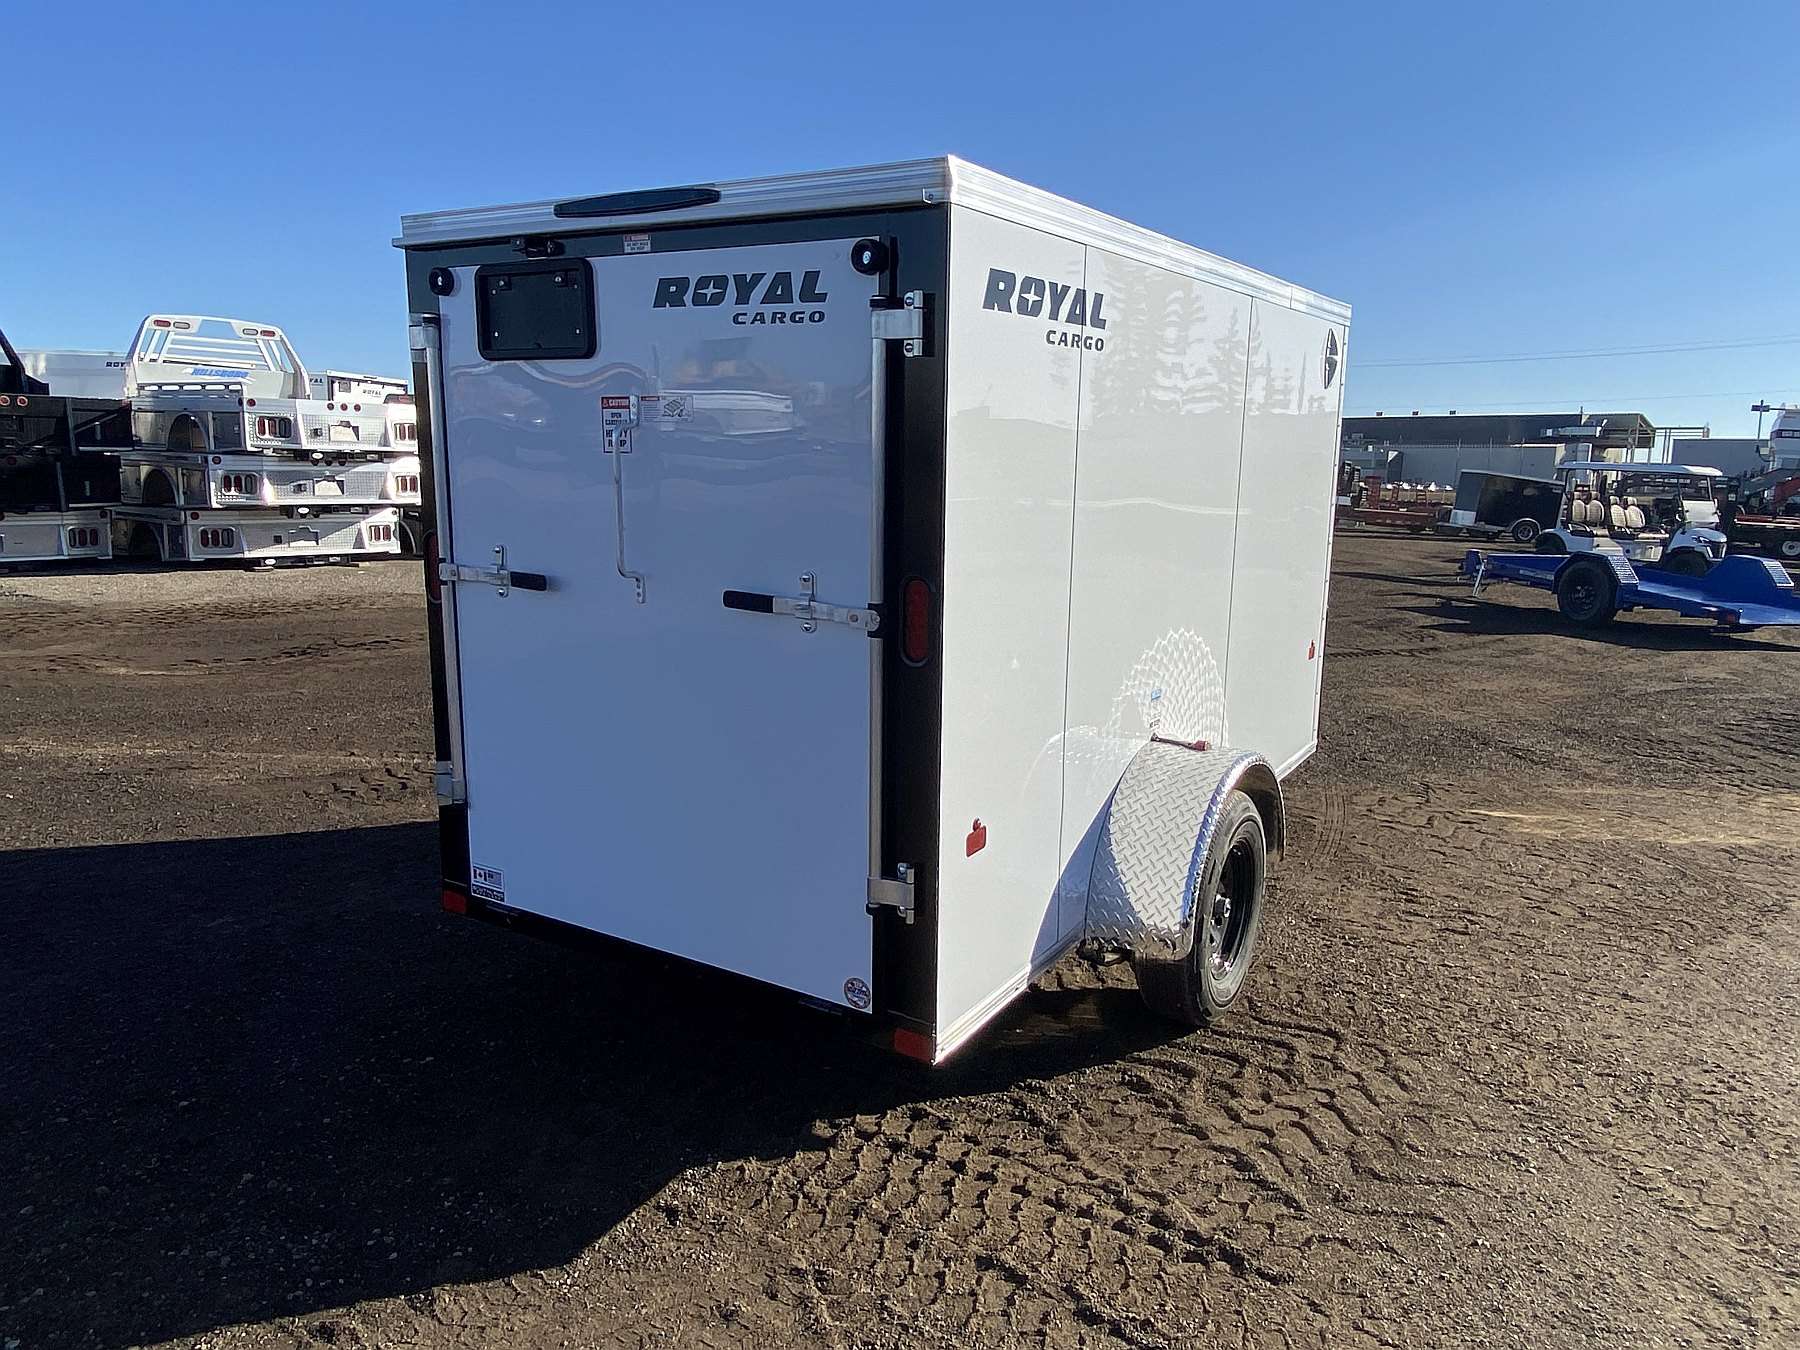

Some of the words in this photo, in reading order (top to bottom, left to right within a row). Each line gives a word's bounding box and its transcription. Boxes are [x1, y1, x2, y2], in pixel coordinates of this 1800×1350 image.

[653, 270, 828, 309] ROYAL
[982, 267, 1107, 330] ROYAL
[732, 310, 826, 325] CARGO
[1045, 329, 1105, 352] CARGO
[605, 429, 628, 438] HEVY
